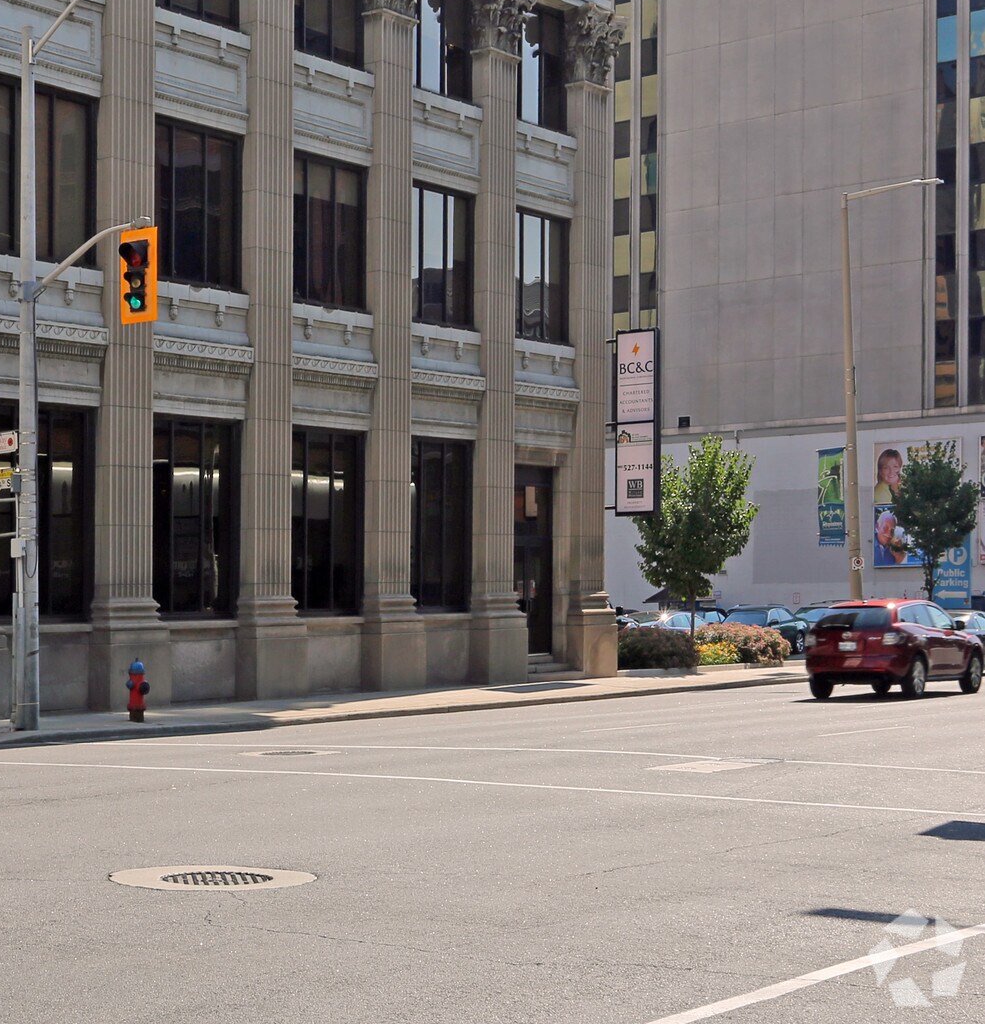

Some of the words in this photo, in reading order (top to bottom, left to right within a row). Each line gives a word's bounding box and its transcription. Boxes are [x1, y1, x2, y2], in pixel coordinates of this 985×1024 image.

[619, 360, 653, 375] BC&C
[619, 397, 653, 405] ACCOUNTANTS
[623, 463, 653, 472] 527-1144
[628, 480, 643, 489] WB
[937, 568, 965, 577] Public
